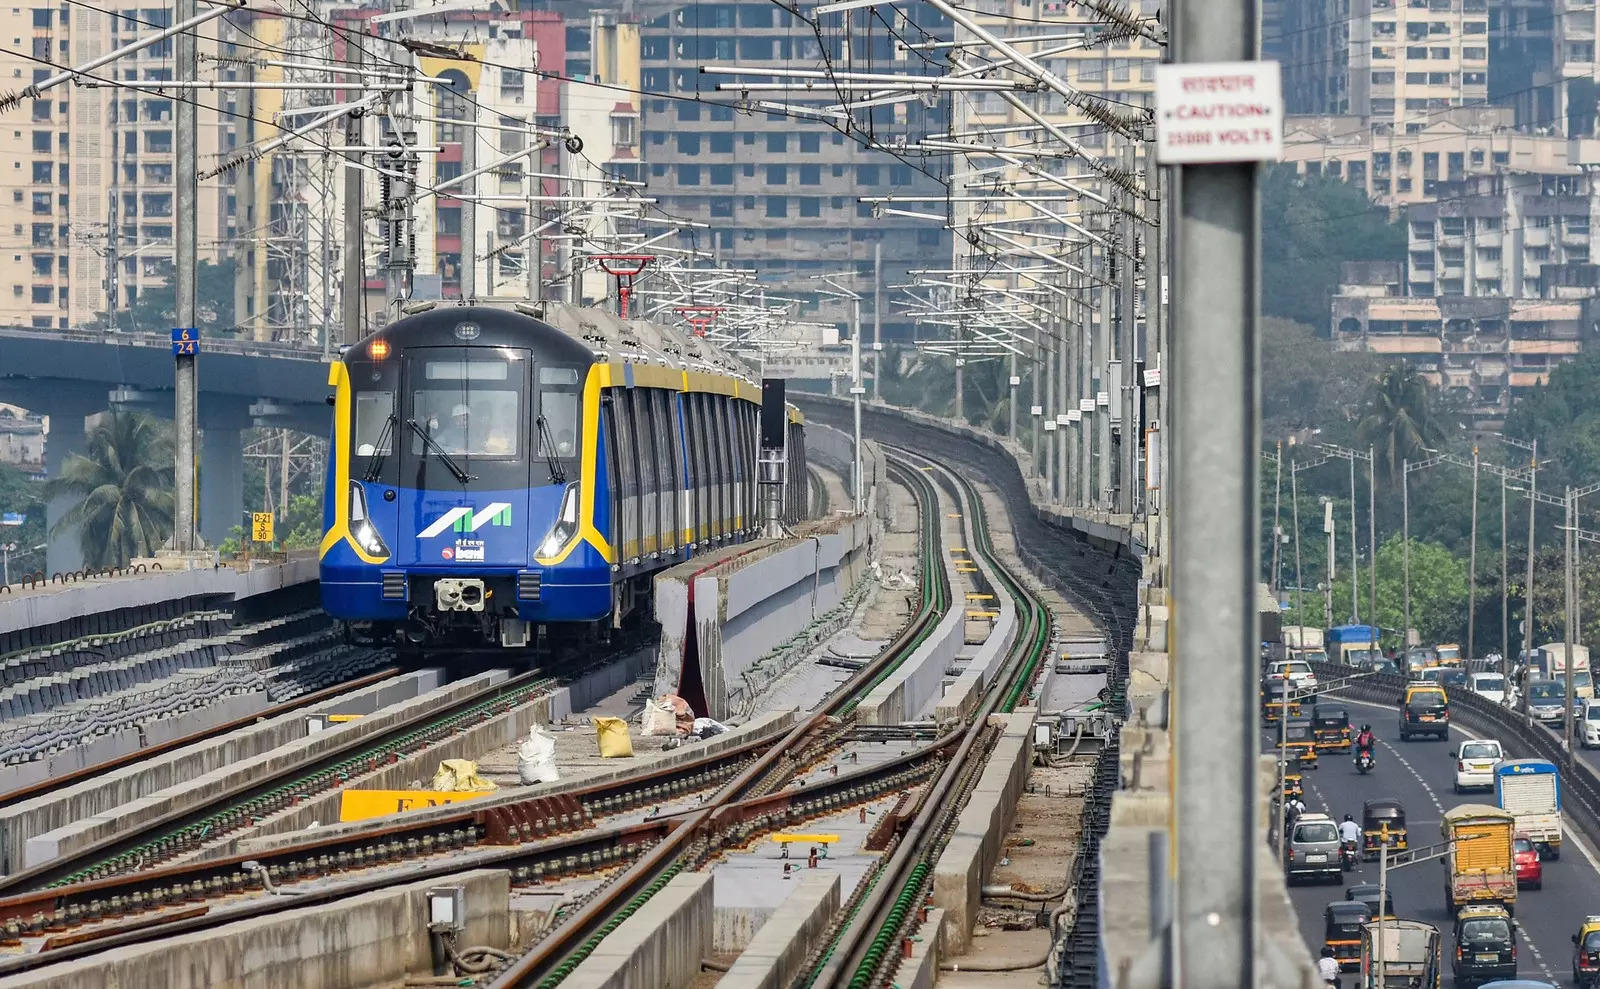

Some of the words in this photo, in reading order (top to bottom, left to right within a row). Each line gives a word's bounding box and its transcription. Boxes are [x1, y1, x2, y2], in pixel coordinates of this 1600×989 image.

[1216, 128, 1272, 144] VOLTS
[181, 329, 189, 340] 6
[178, 342, 193, 354] 24
[260, 522, 266, 531] S
[258, 532, 267, 540] 90
